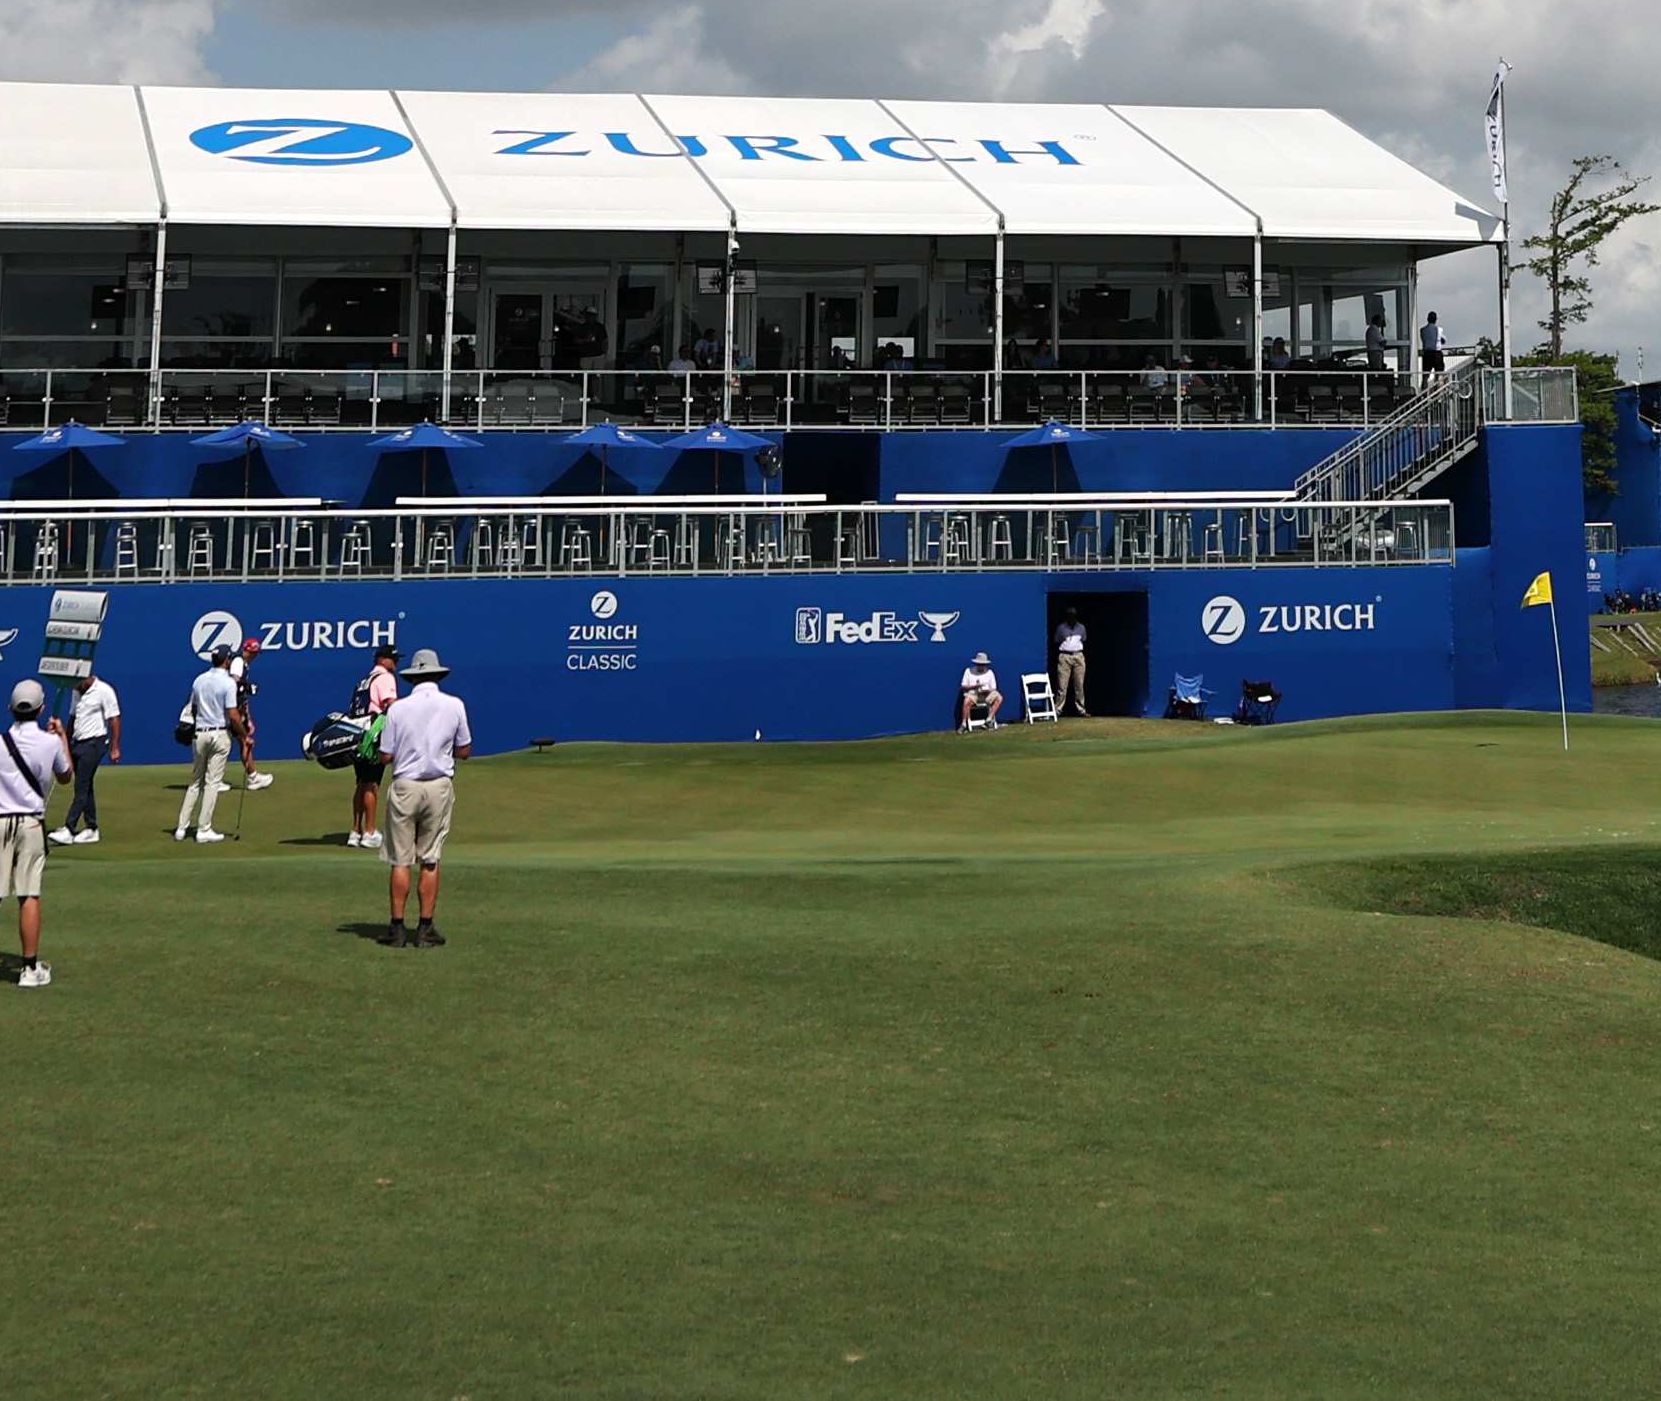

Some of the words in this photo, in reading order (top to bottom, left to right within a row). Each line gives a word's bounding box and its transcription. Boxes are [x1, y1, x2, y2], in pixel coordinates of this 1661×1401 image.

[490, 129, 1086, 167] ZURICH
[568, 624, 638, 640] ZURICH
[825, 611, 919, 644] FedEx
[1258, 603, 1375, 633] ZURICH
[259, 620, 397, 650] ZURICH
[566, 654, 638, 670] CLASSIC
